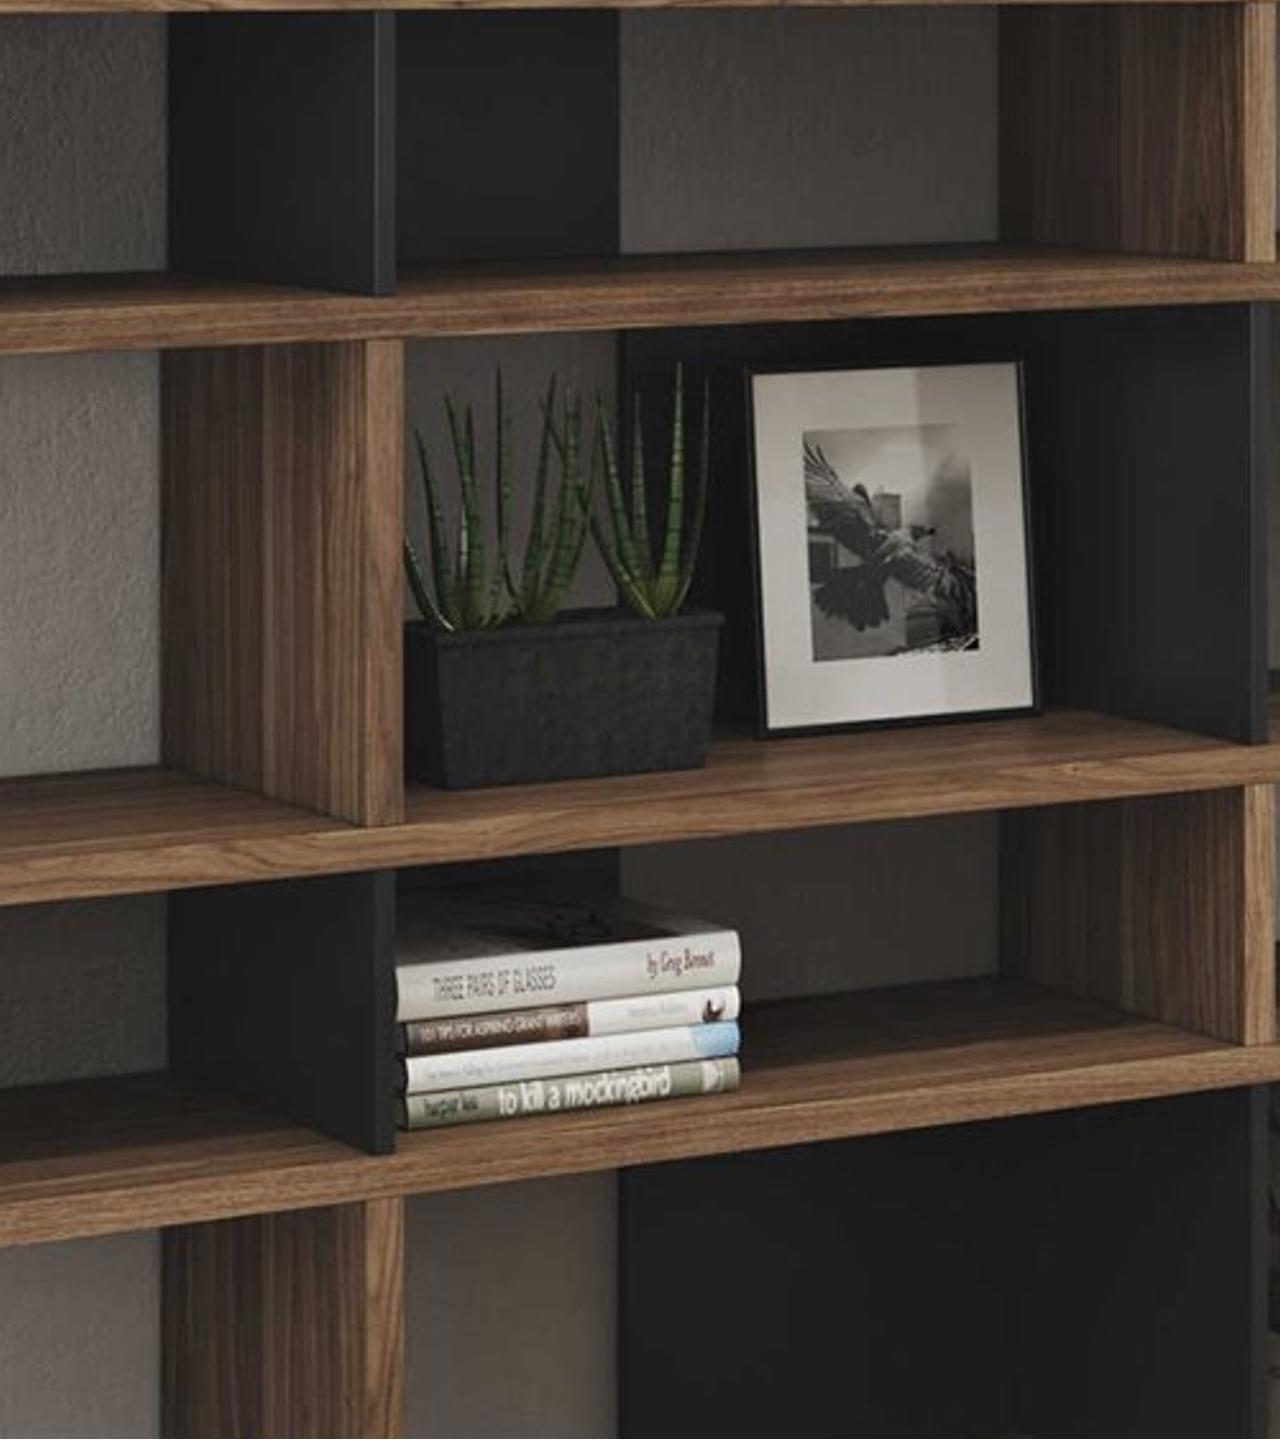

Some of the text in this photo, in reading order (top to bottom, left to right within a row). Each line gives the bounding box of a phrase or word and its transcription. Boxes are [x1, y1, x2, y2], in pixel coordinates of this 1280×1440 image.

[497, 1064, 671, 1116] to kill a mockingbird
